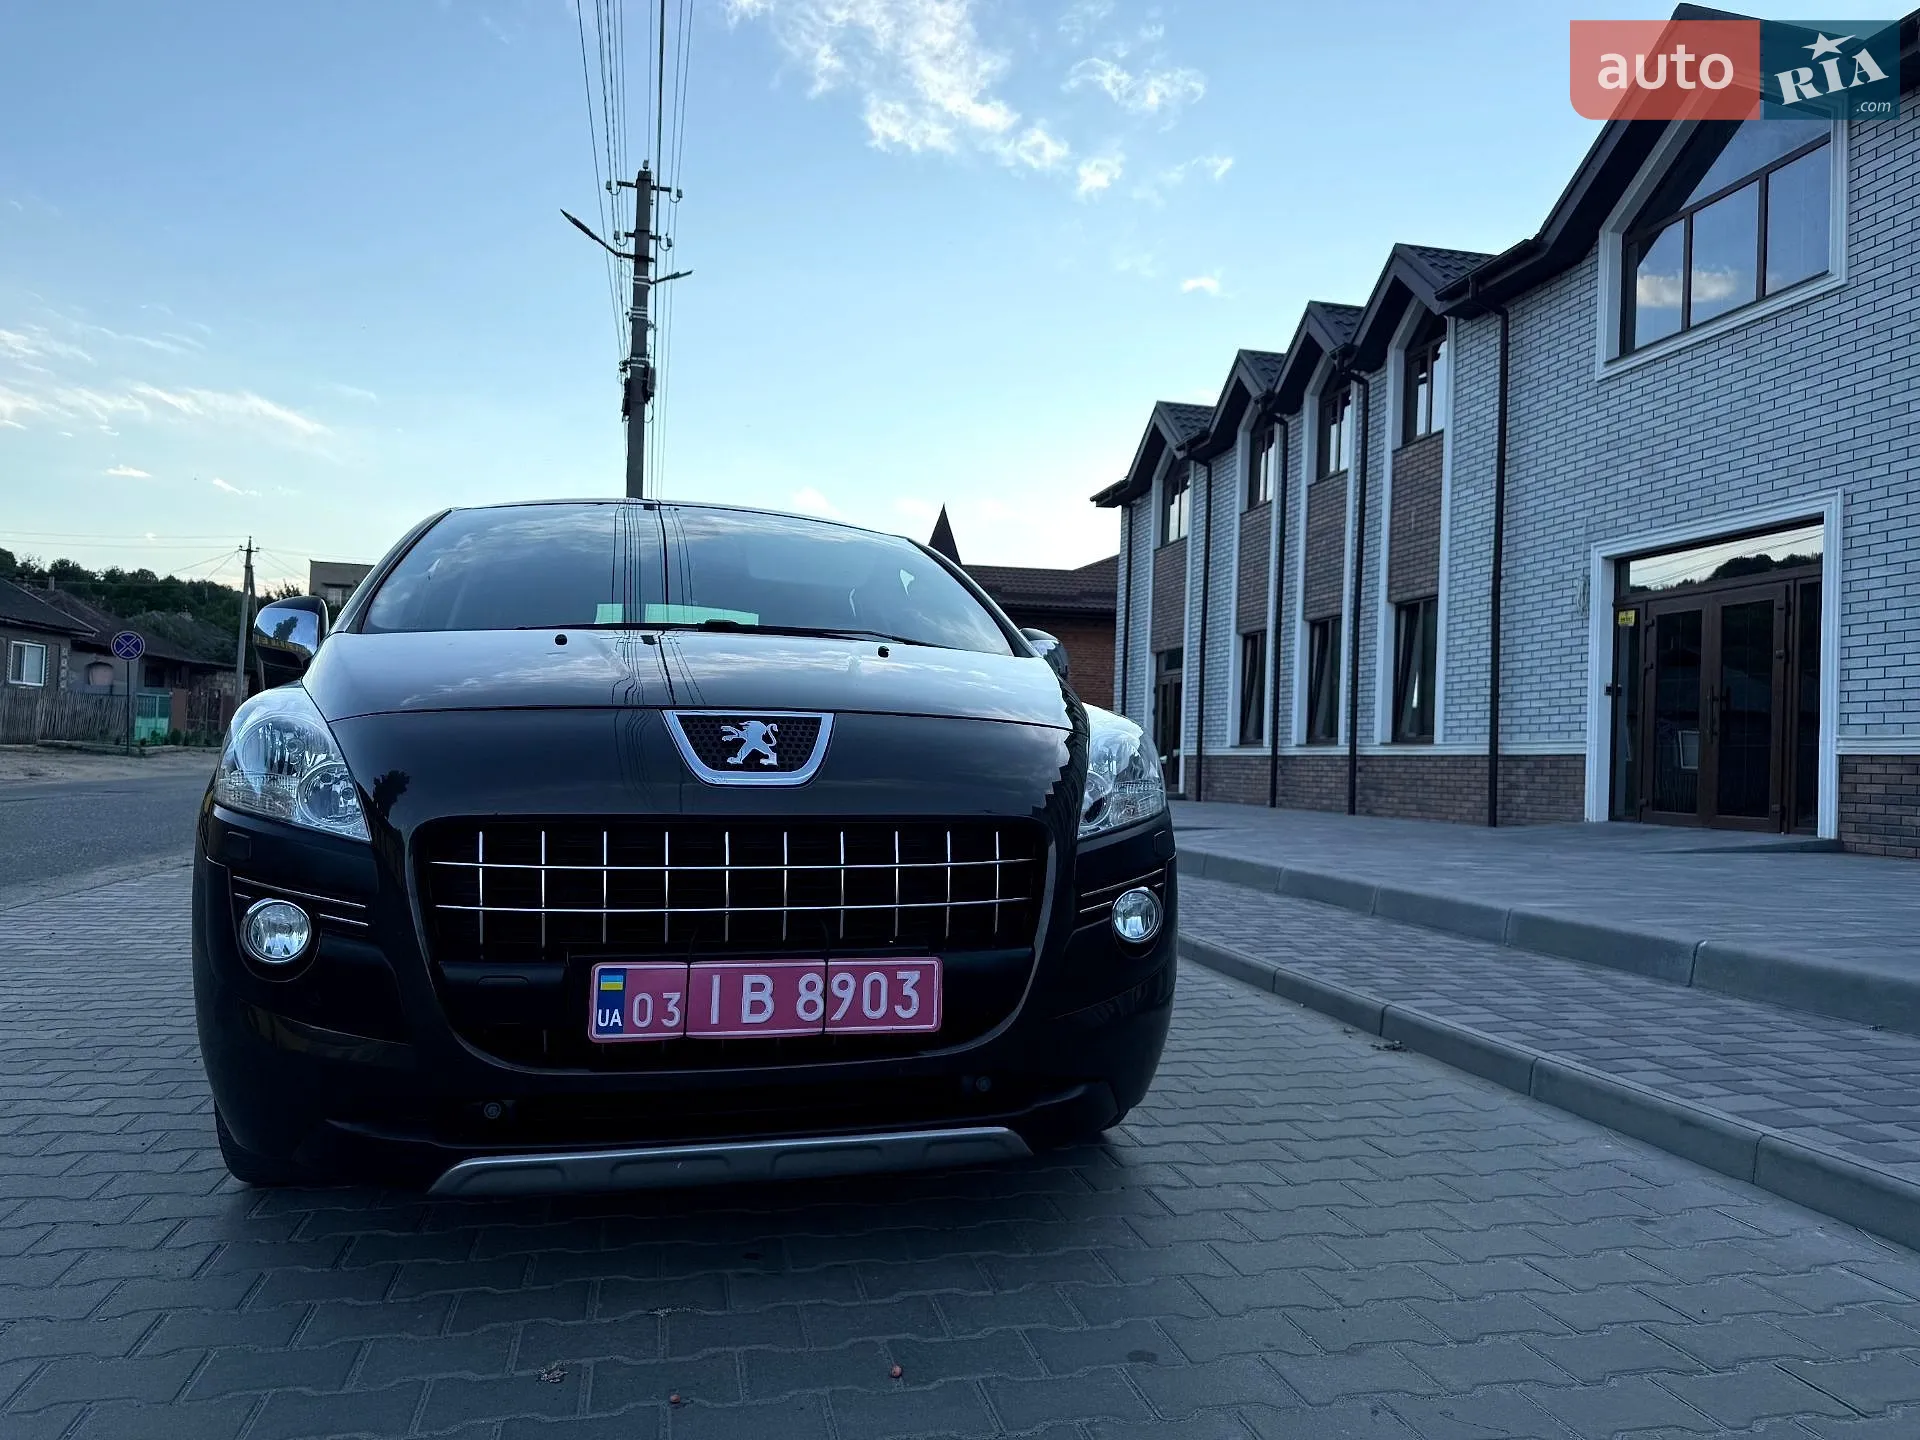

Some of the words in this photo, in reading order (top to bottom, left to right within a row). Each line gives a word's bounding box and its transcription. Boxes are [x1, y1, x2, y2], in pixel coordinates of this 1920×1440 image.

[632, 992, 681, 1027] 03
[710, 974, 774, 1024] IB
[796, 971, 920, 1021] 8903
[597, 1009, 622, 1027] UA
